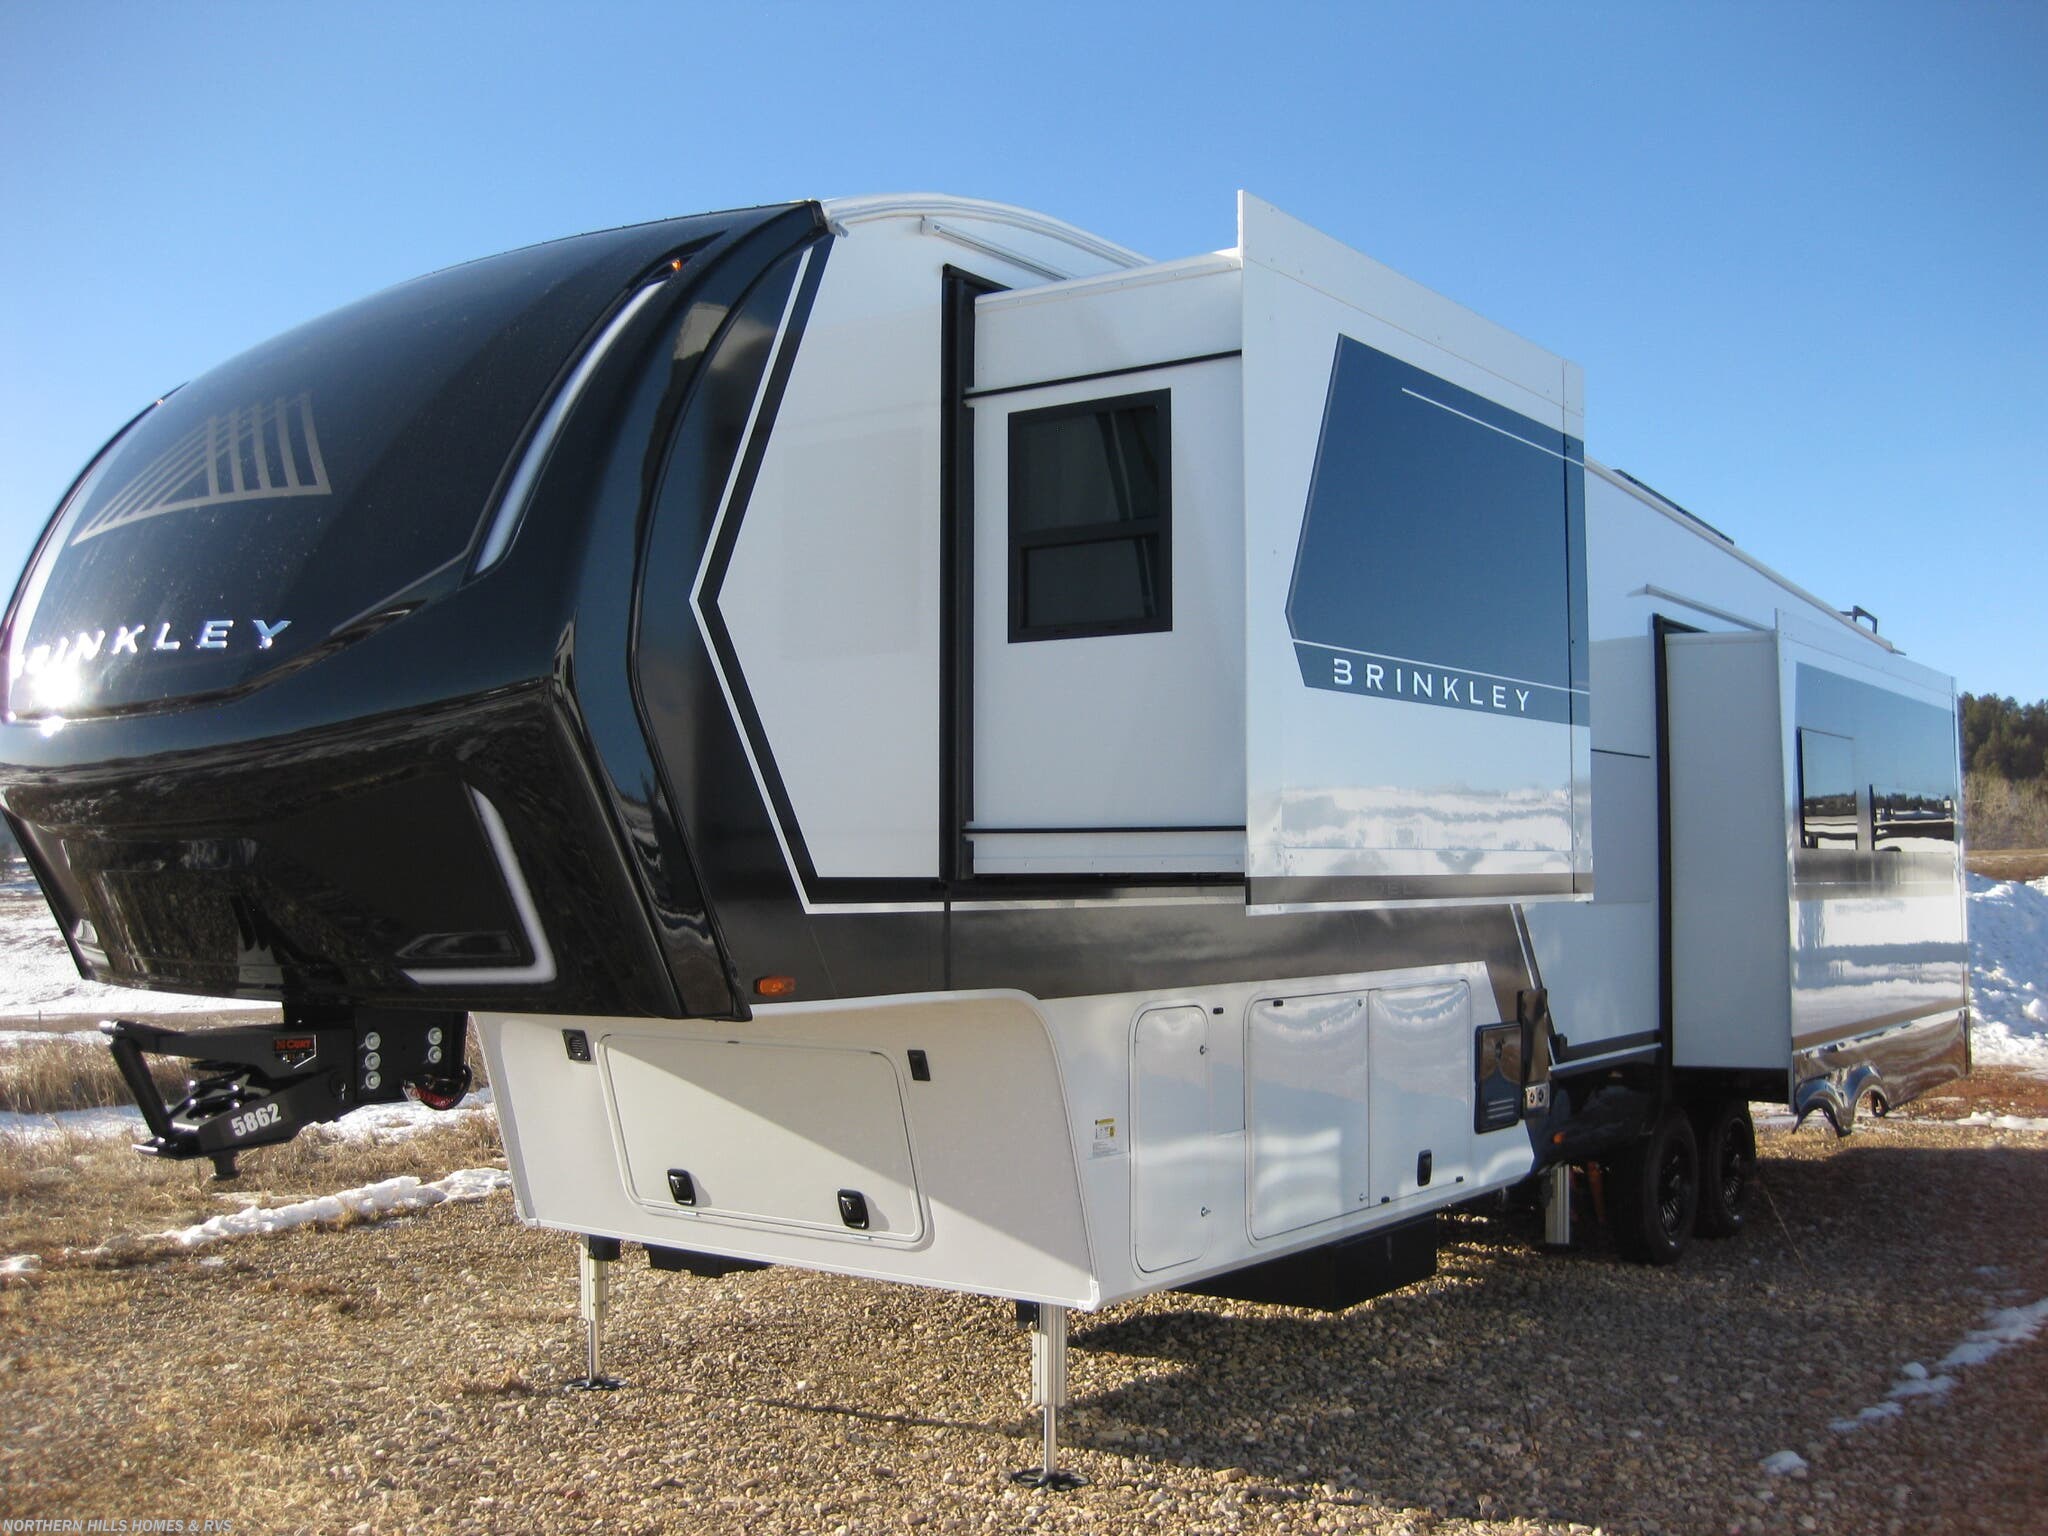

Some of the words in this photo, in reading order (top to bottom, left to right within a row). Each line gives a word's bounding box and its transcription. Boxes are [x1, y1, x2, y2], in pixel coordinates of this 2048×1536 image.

[11, 619, 292, 677] INKLEY
[1333, 658, 1529, 712] BRINKLEY
[231, 1103, 282, 1136] 5862
